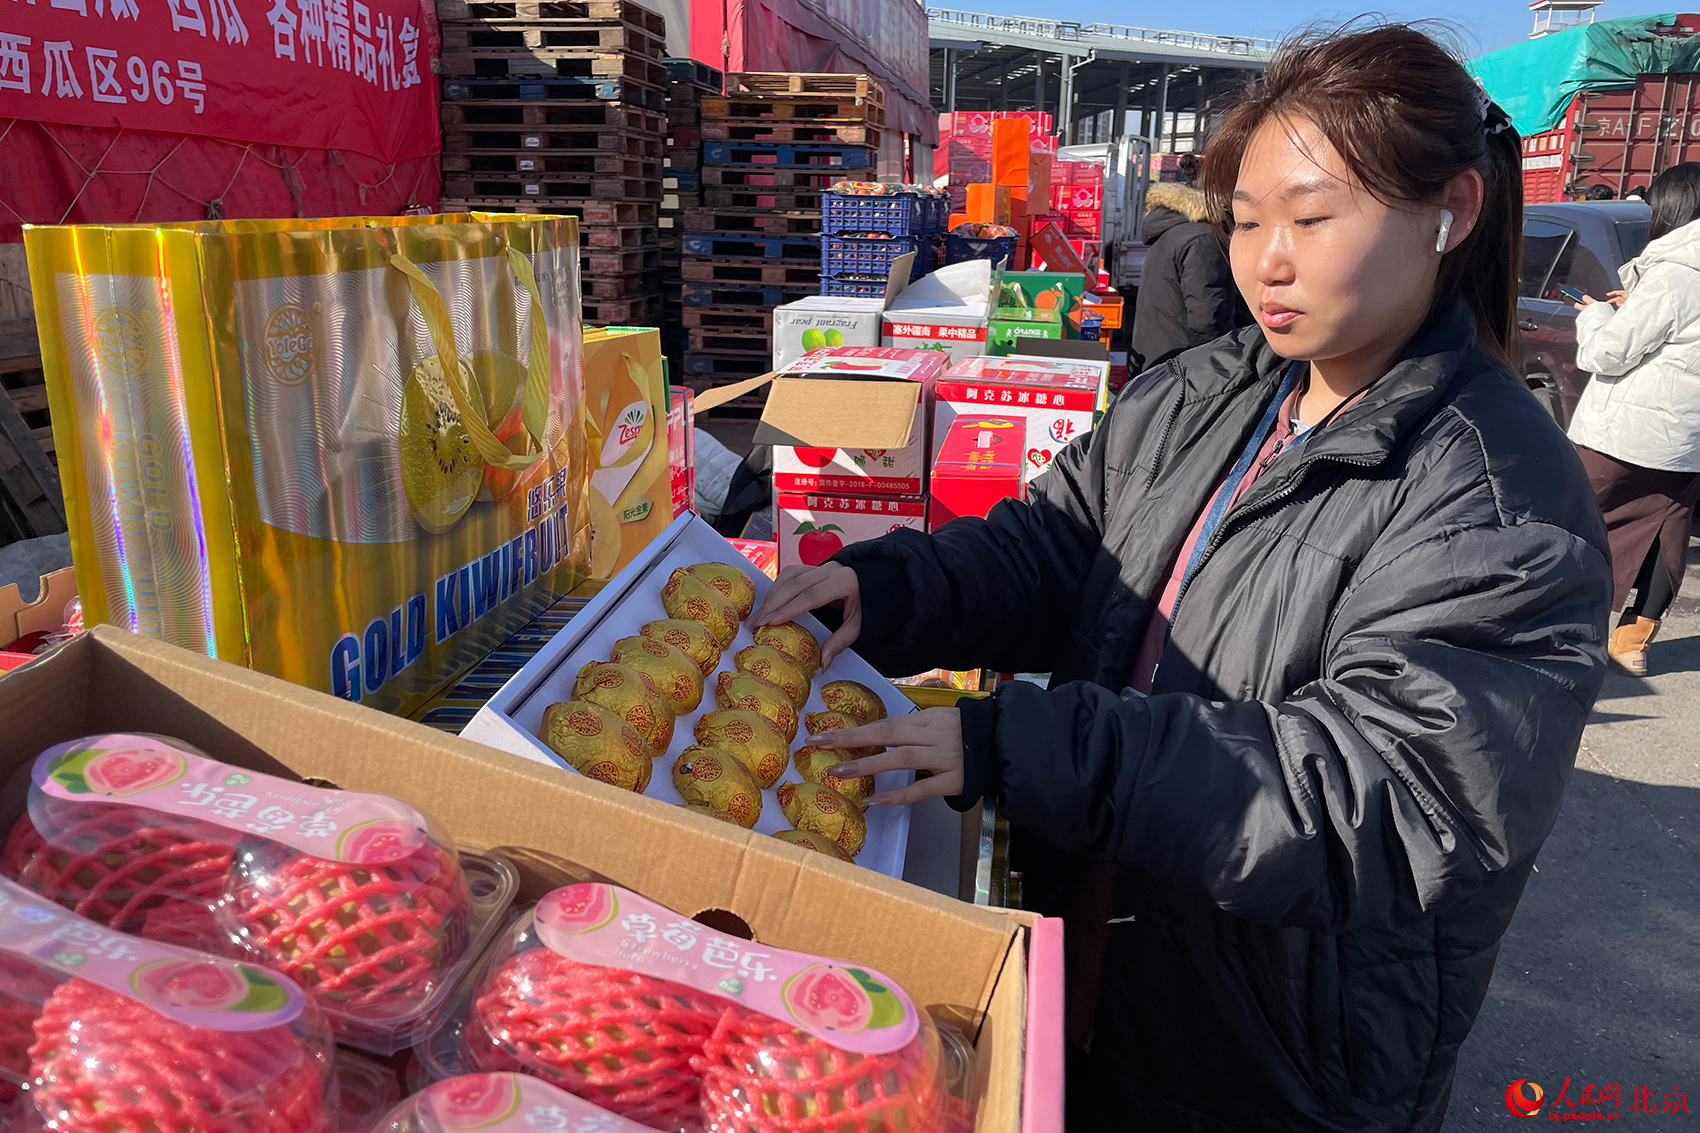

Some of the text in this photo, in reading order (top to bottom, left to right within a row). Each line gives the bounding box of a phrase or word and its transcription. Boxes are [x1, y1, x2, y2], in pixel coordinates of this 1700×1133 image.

[266, 0, 421, 92] 各种精品礼盒
[0, 32, 207, 114] 西瓜区96号
[790, 317, 858, 330] Fragrant pear
[938, 327, 977, 339] 果中精品
[966, 387, 1065, 406] 阿克苏冰糖心
[666, 400, 694, 434] PPLE
[618, 424, 643, 445] Zesp
[623, 502, 648, 520] 阳光金果
[807, 496, 899, 512] 阿克苏冰糖心
[329, 591, 427, 704] GOLD
[435, 501, 570, 645] KIWIFRUIT
[176, 782, 338, 838] 草莓芭乐
[620, 938, 699, 971] Strawberry
[621, 912, 778, 982] 草莓芭乐
